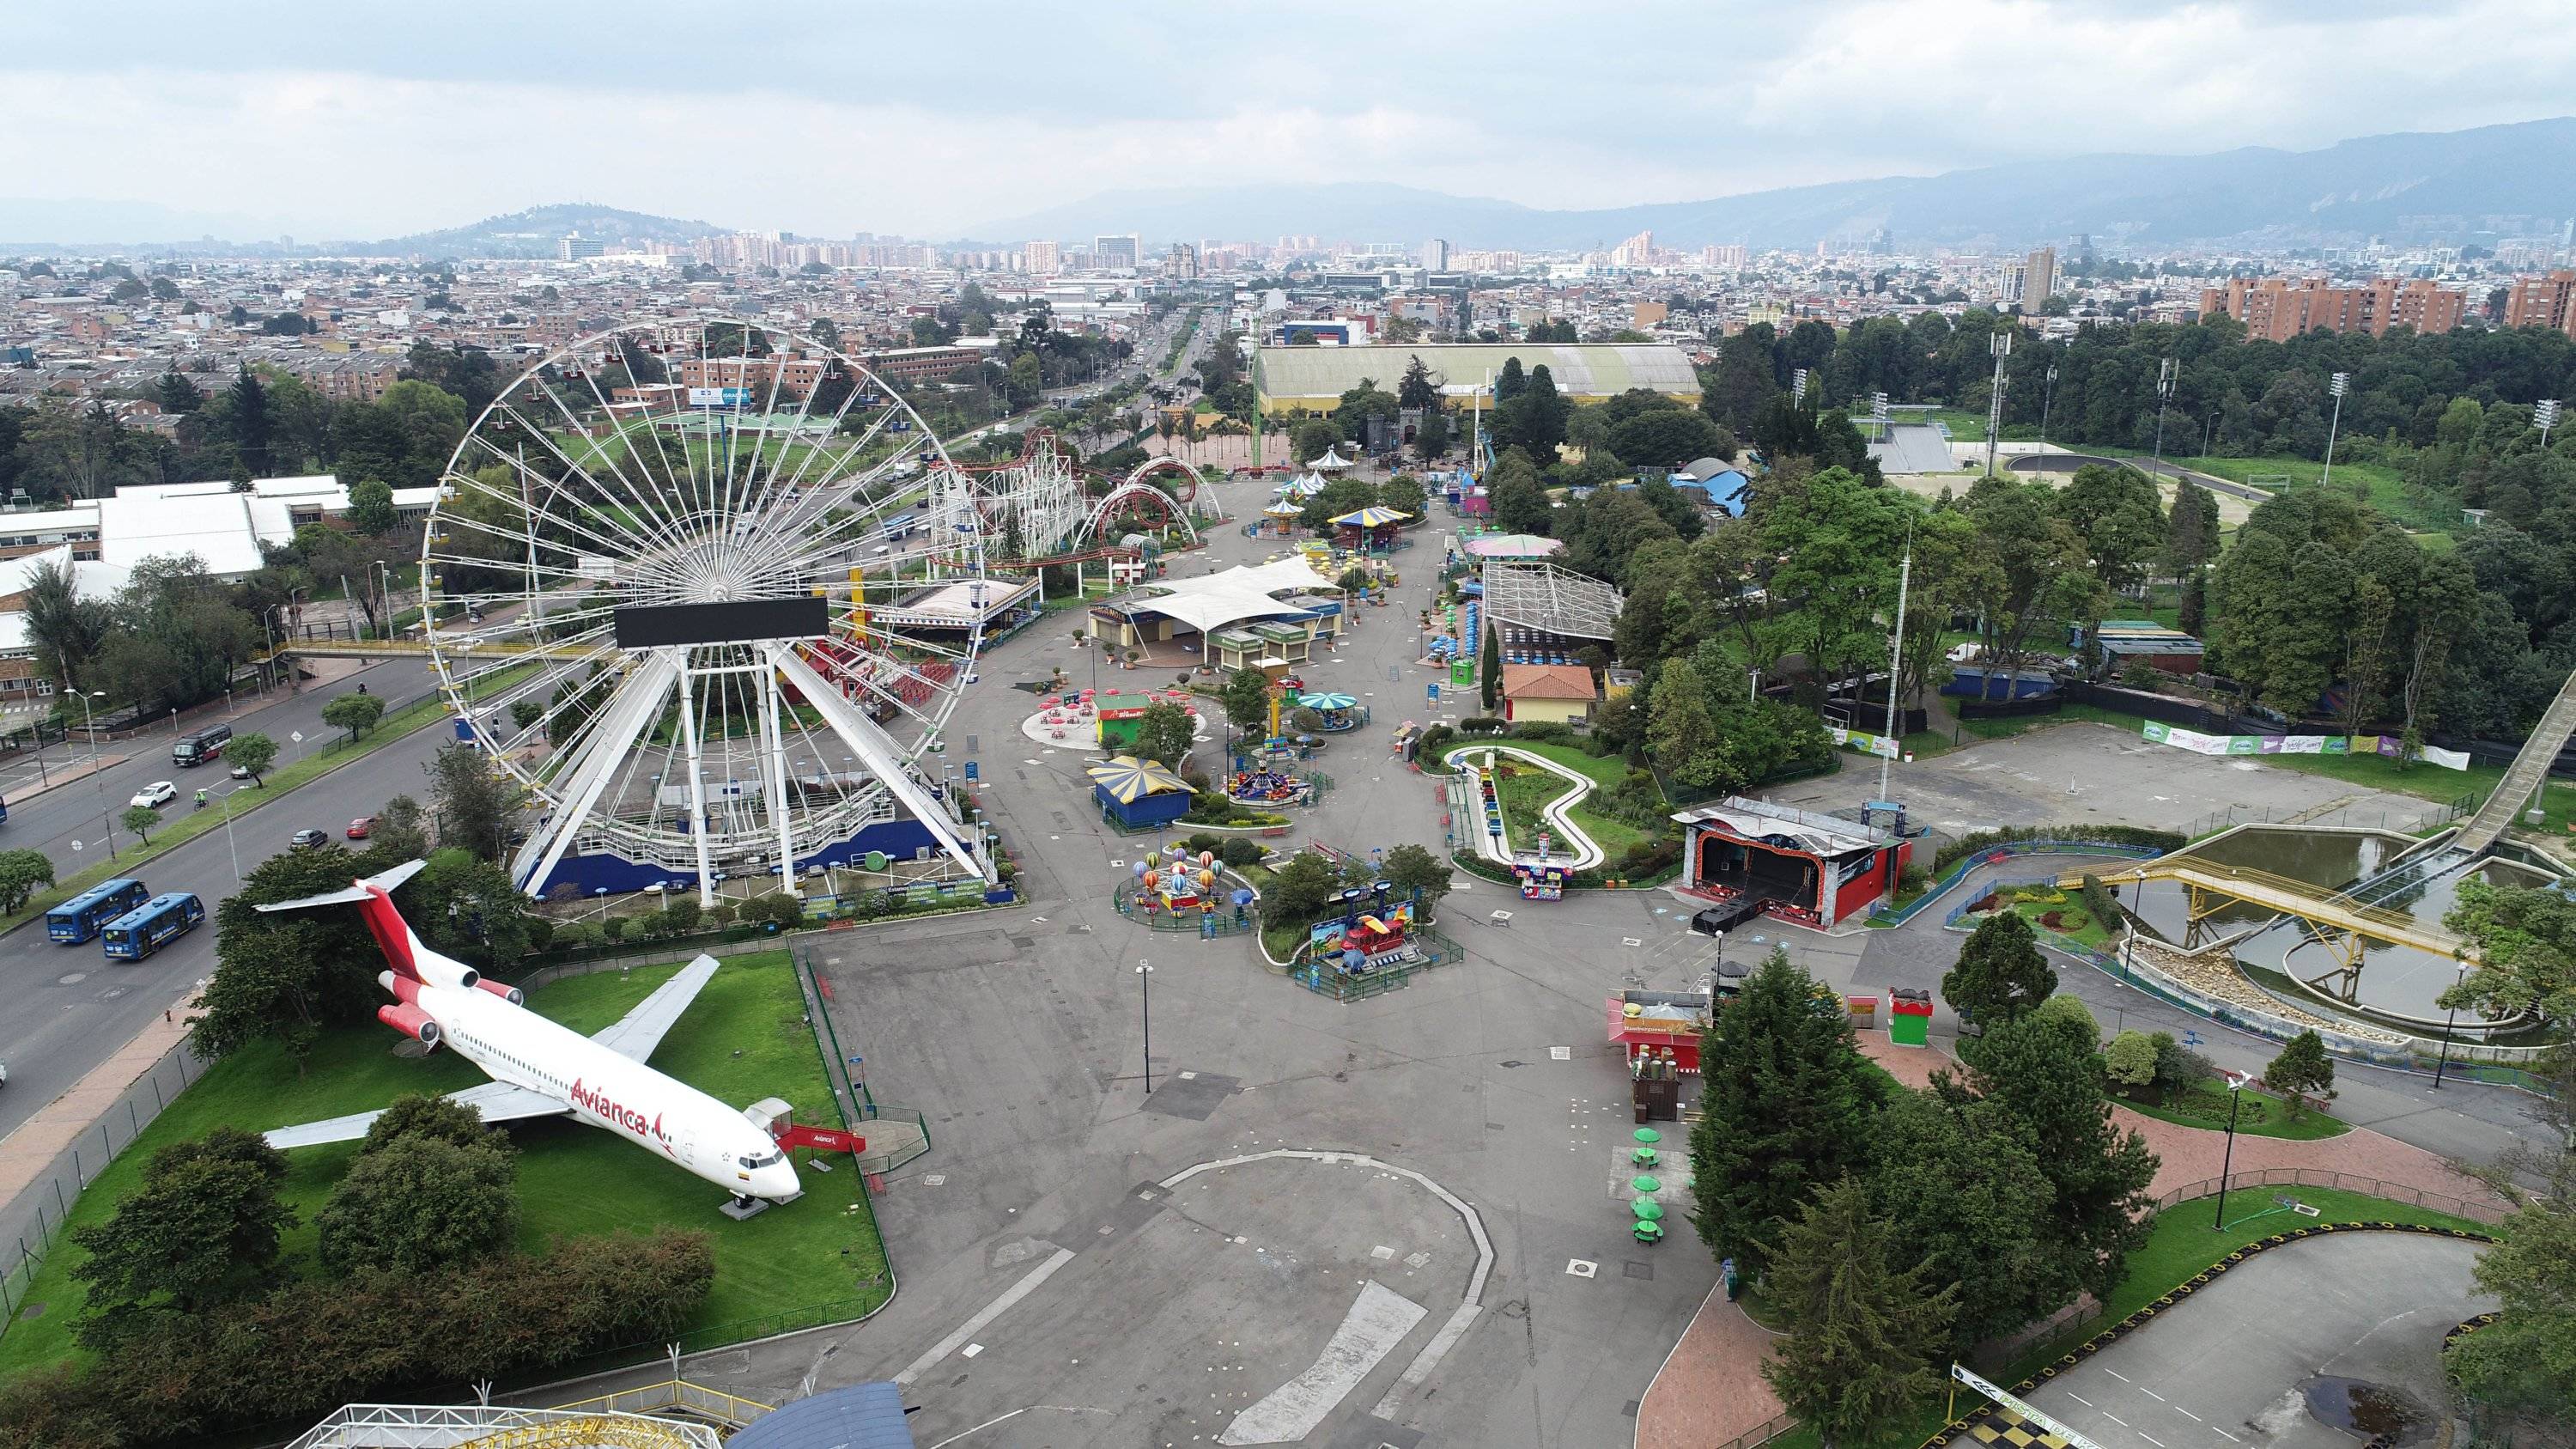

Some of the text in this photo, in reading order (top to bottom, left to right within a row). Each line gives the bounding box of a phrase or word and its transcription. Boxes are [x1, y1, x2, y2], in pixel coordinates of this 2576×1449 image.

[570, 1077, 647, 1137] Avianca
[813, 1134, 832, 1143] Avianca
[1997, 1393, 2047, 1428] PISTA
[2049, 1423, 2075, 1442] DE
